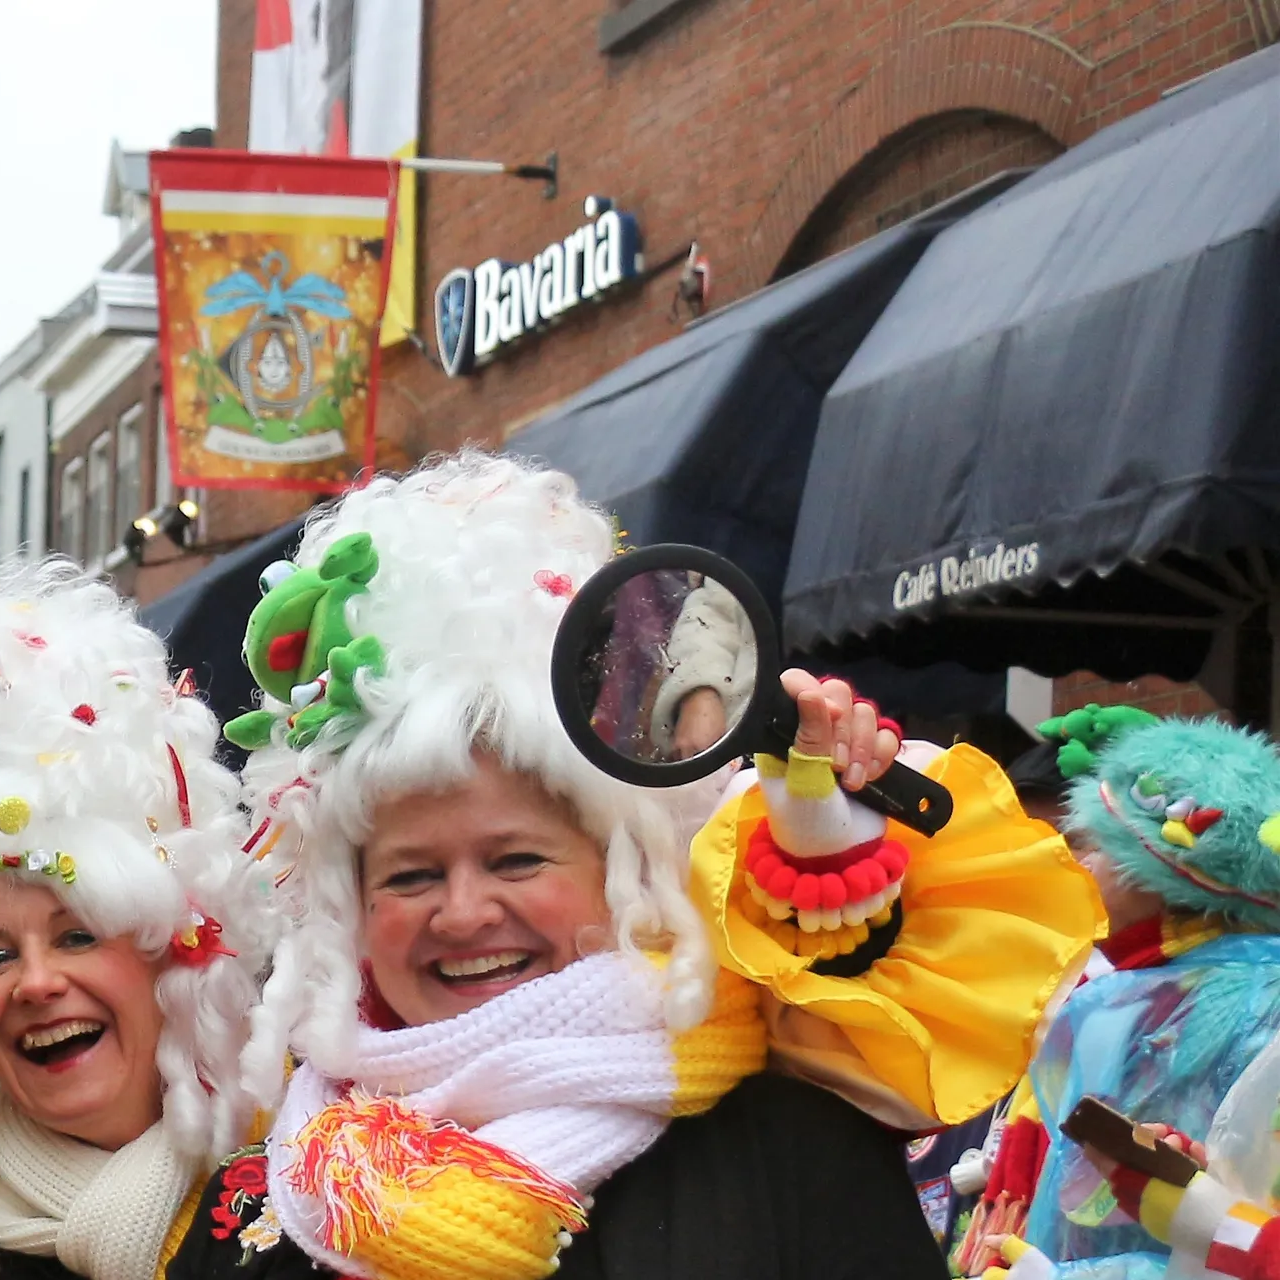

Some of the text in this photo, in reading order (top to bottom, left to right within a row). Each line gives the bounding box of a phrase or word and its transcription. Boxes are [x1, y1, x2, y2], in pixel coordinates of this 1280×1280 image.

[474, 195, 623, 357] Bavaria
[892, 541, 1039, 610] Café Reinders
